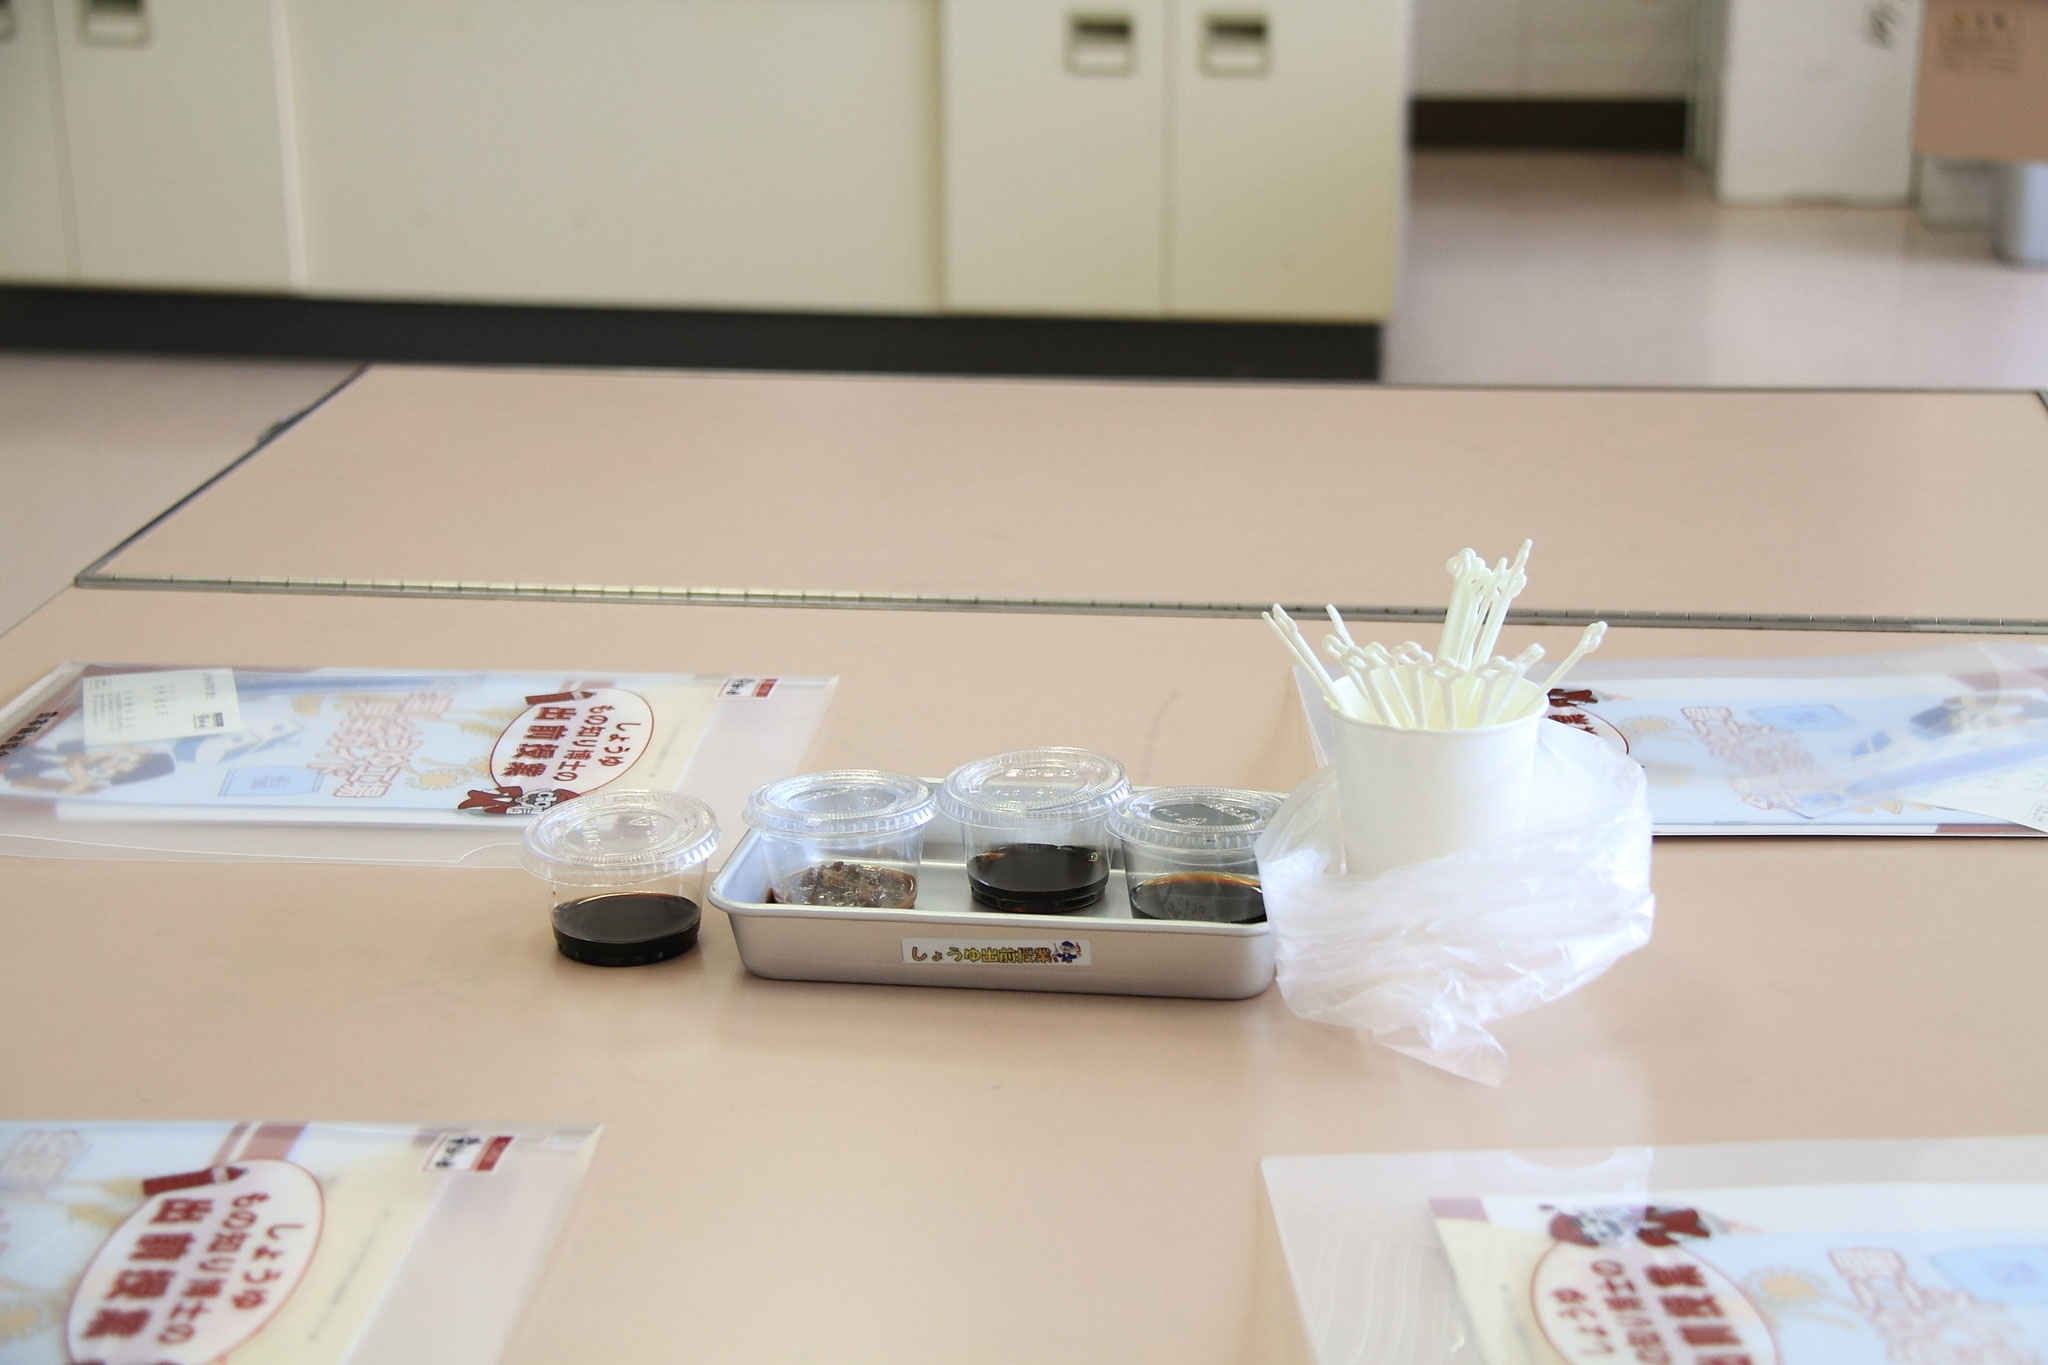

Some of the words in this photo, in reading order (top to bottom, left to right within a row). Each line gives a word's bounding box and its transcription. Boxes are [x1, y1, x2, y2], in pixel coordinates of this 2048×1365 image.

[500, 706, 577, 777] 出前授業
[553, 704, 615, 782] もの知り博士の
[598, 722, 642, 767] しょうゆ
[911, 946, 1052, 963] しょうゆ出前授業
[82, 1198, 213, 1340] 出前授業
[231, 1223, 304, 1311] しょうゆ
